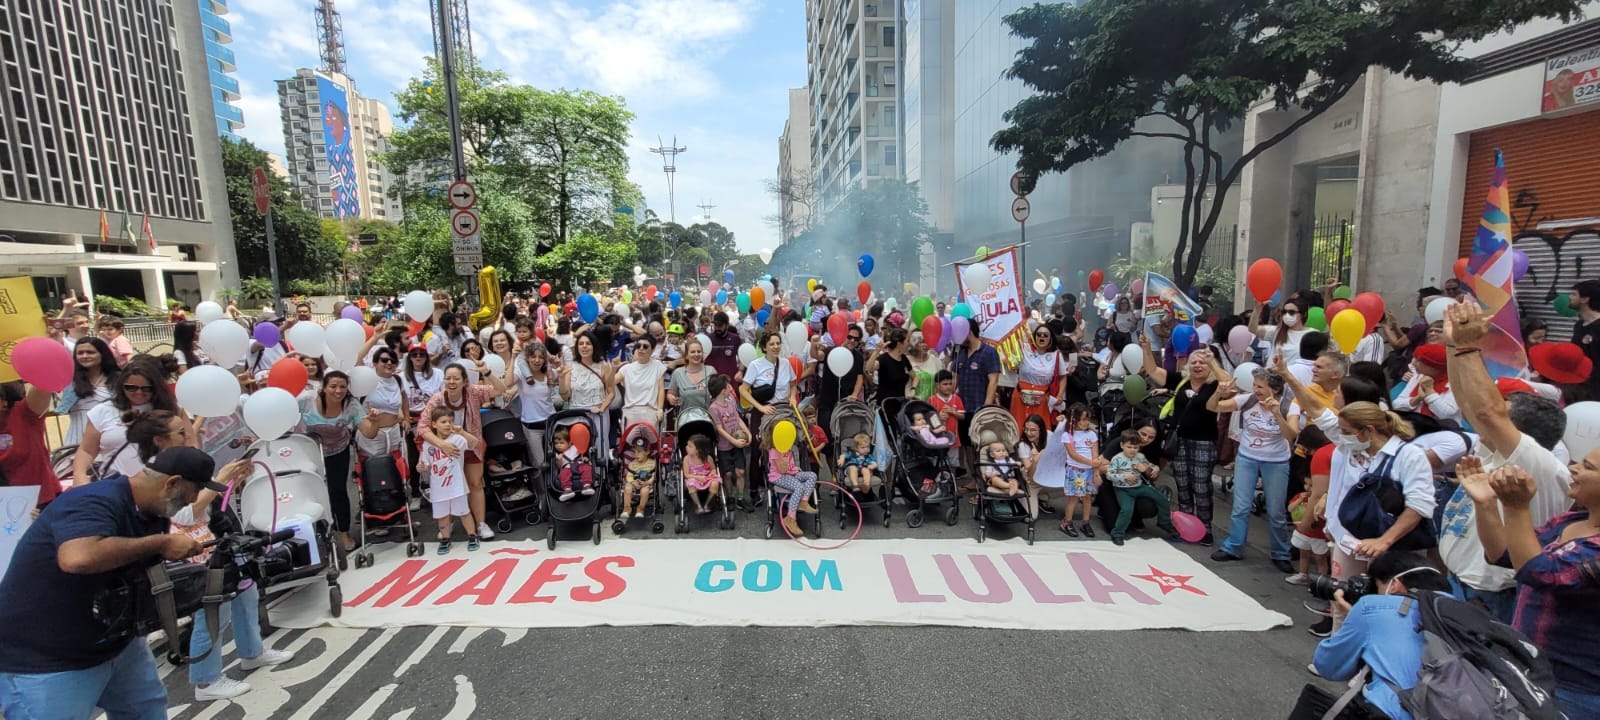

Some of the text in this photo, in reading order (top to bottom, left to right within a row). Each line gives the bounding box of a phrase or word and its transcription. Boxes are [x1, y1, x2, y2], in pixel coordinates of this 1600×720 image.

[981, 292, 997, 301] COM
[342, 547, 1182, 608] MÃES COM LULA 13
